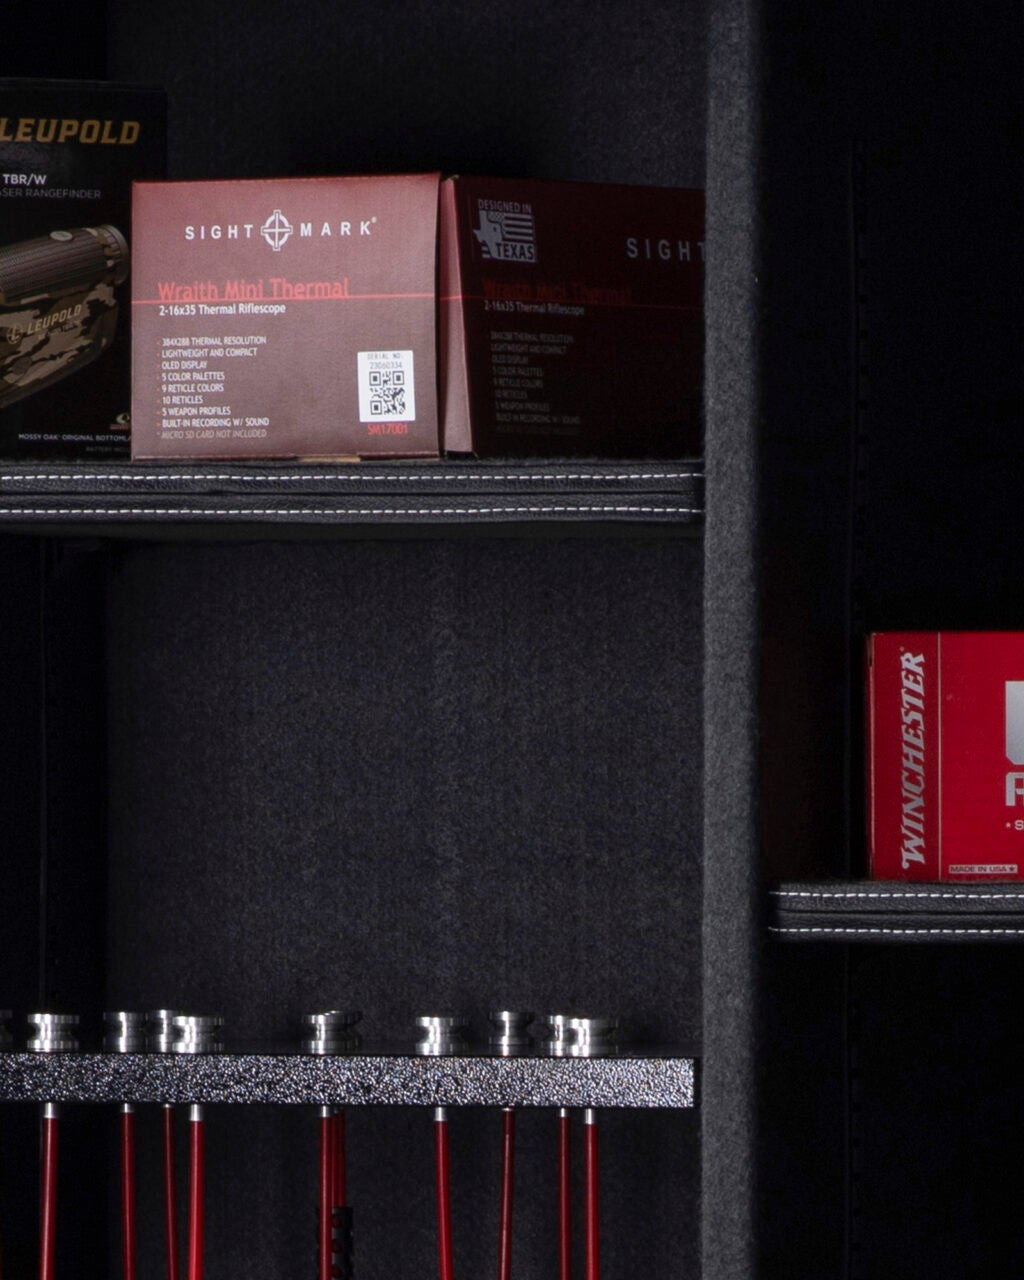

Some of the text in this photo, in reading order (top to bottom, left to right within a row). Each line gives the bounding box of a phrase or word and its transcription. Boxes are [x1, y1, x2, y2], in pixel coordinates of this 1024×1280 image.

[0, 117, 141, 145] LEUPOLD
[2, 173, 47, 186] TBR/W
[25, 188, 101, 199] RANGEFINDER
[478, 199, 532, 214] DESIGNED IN
[495, 242, 534, 260] TEXAS
[158, 277, 349, 300] Wraith Mini Thermal
[159, 302, 287, 316] 2-16x35 Thermal Riflescope
[27, 304, 83, 335] LEUPOLD
[191, 337, 223, 346] THERMAL
[223, 335, 267, 345] RESOLUTION
[161, 347, 258, 358] LIGHTWEIGHT AND COMPACT
[161, 361, 208, 370] OLED DISPLAY
[168, 372, 191, 381] COLOR
[192, 371, 225, 380] PALETTES
[168, 384, 196, 392] RETICLE
[196, 383, 224, 392] COLORS
[162, 395, 204, 404] 10 RETICLES
[168, 407, 198, 416] WEAPON
[199, 406, 231, 415] PROFILES
[191, 418, 231, 427] RECORDING
[245, 417, 270, 427] SOUND
[18, 433, 42, 441] MOSSY
[901, 652, 925, 869] WINCHESTER
